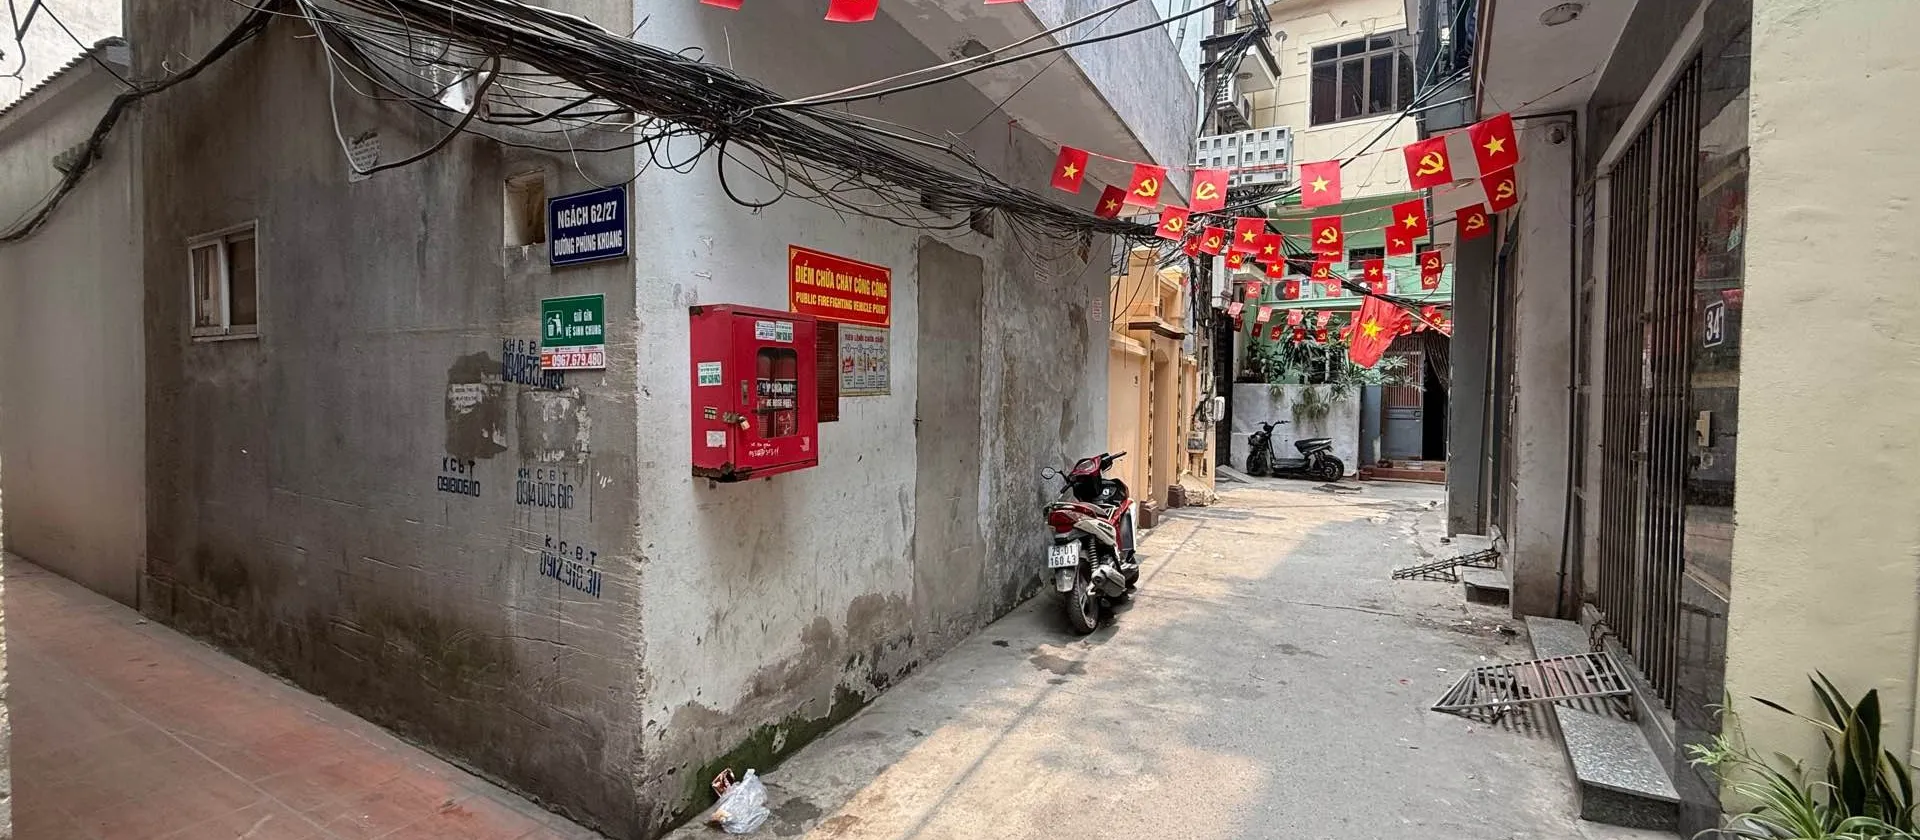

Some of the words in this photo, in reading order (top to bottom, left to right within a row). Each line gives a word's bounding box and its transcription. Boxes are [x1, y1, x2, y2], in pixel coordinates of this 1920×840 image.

[557, 204, 589, 229] NGÁCH
[590, 201, 617, 223] 62/27
[597, 229, 623, 250] KHOANG
[795, 260, 815, 285] ĐIỂM
[816, 268, 835, 289] CHỮA
[836, 272, 853, 292] CHÁY
[854, 275, 871, 295] CÔNG
[795, 292, 817, 305] PUBLIC
[854, 301, 873, 313] VEHICLE
[873, 304, 887, 315] POINT
[1706, 307, 1720, 341] 34
[551, 352, 603, 367] 0967.679.480
